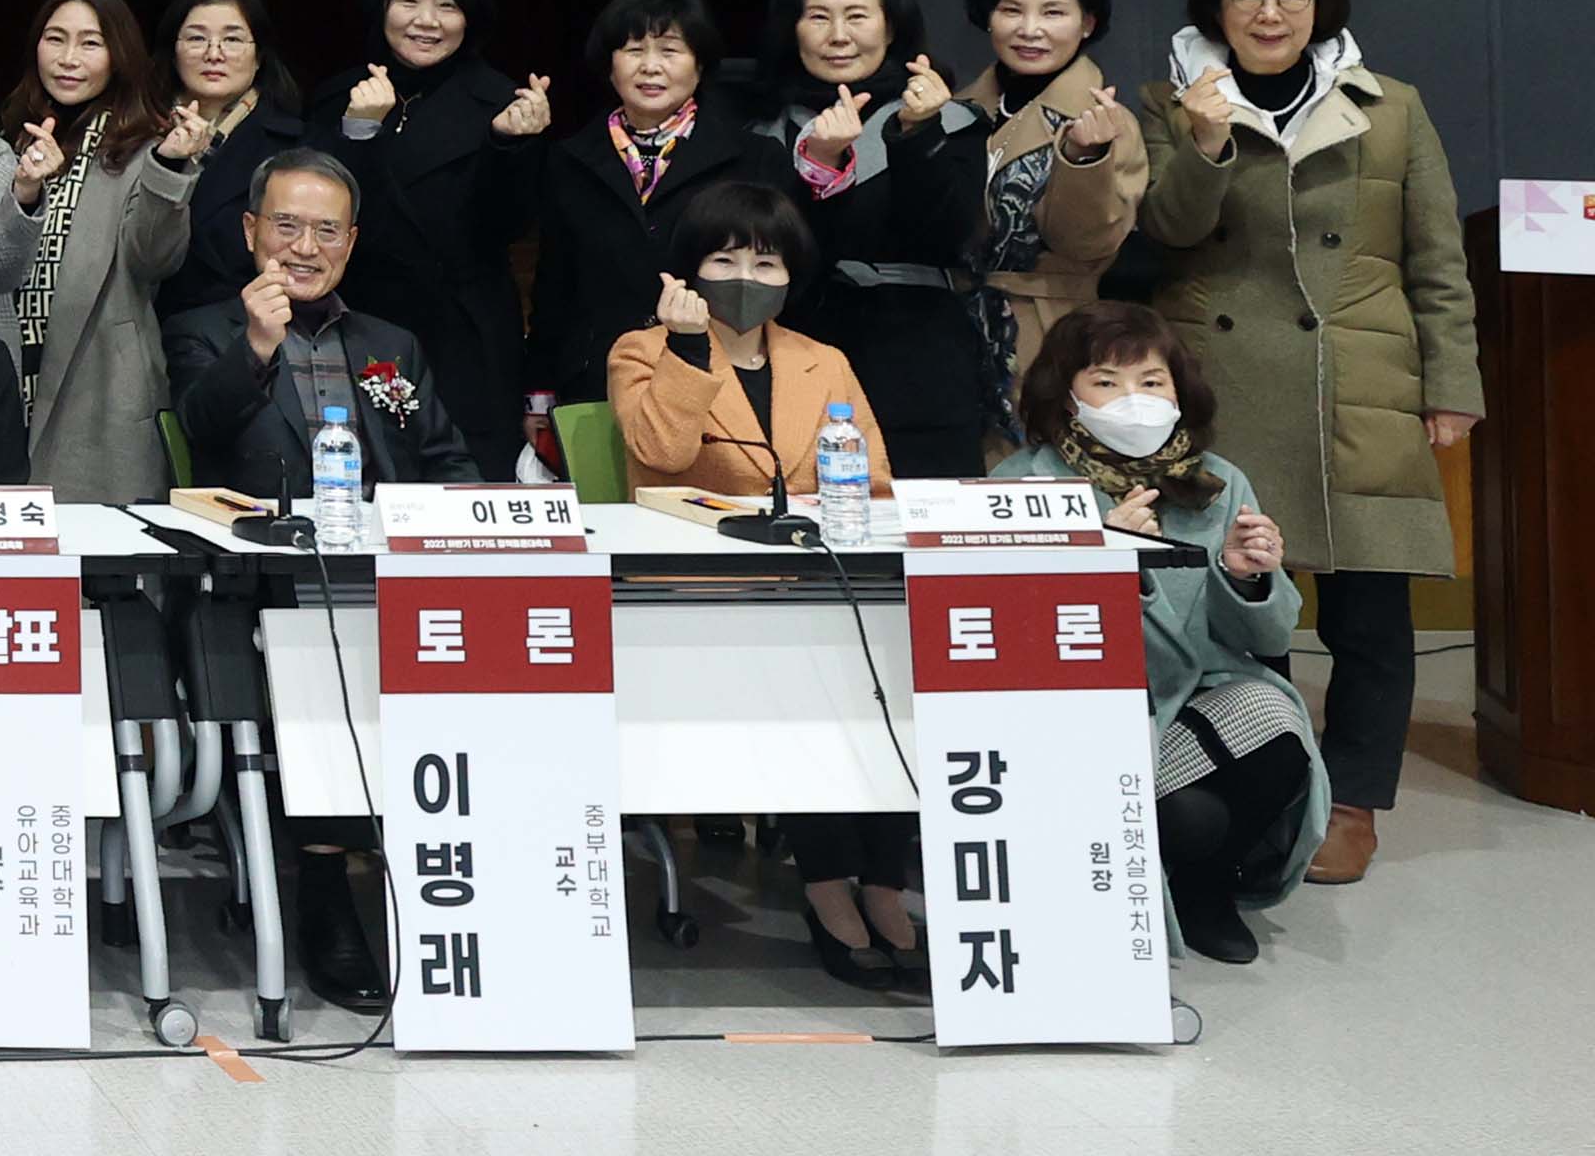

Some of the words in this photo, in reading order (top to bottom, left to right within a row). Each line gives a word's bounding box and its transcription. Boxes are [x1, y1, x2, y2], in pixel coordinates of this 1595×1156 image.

[17, 805, 40, 936] 유아교육과
[51, 805, 74, 935] 중앙대학교
[413, 753, 481, 998] 이병래
[556, 847, 577, 896] 교수
[585, 805, 611, 937] 중부대학교
[947, 750, 1019, 993] 강미자
[1090, 843, 1112, 892] 원장
[1119, 769, 1157, 960] 안산햇살유치원
